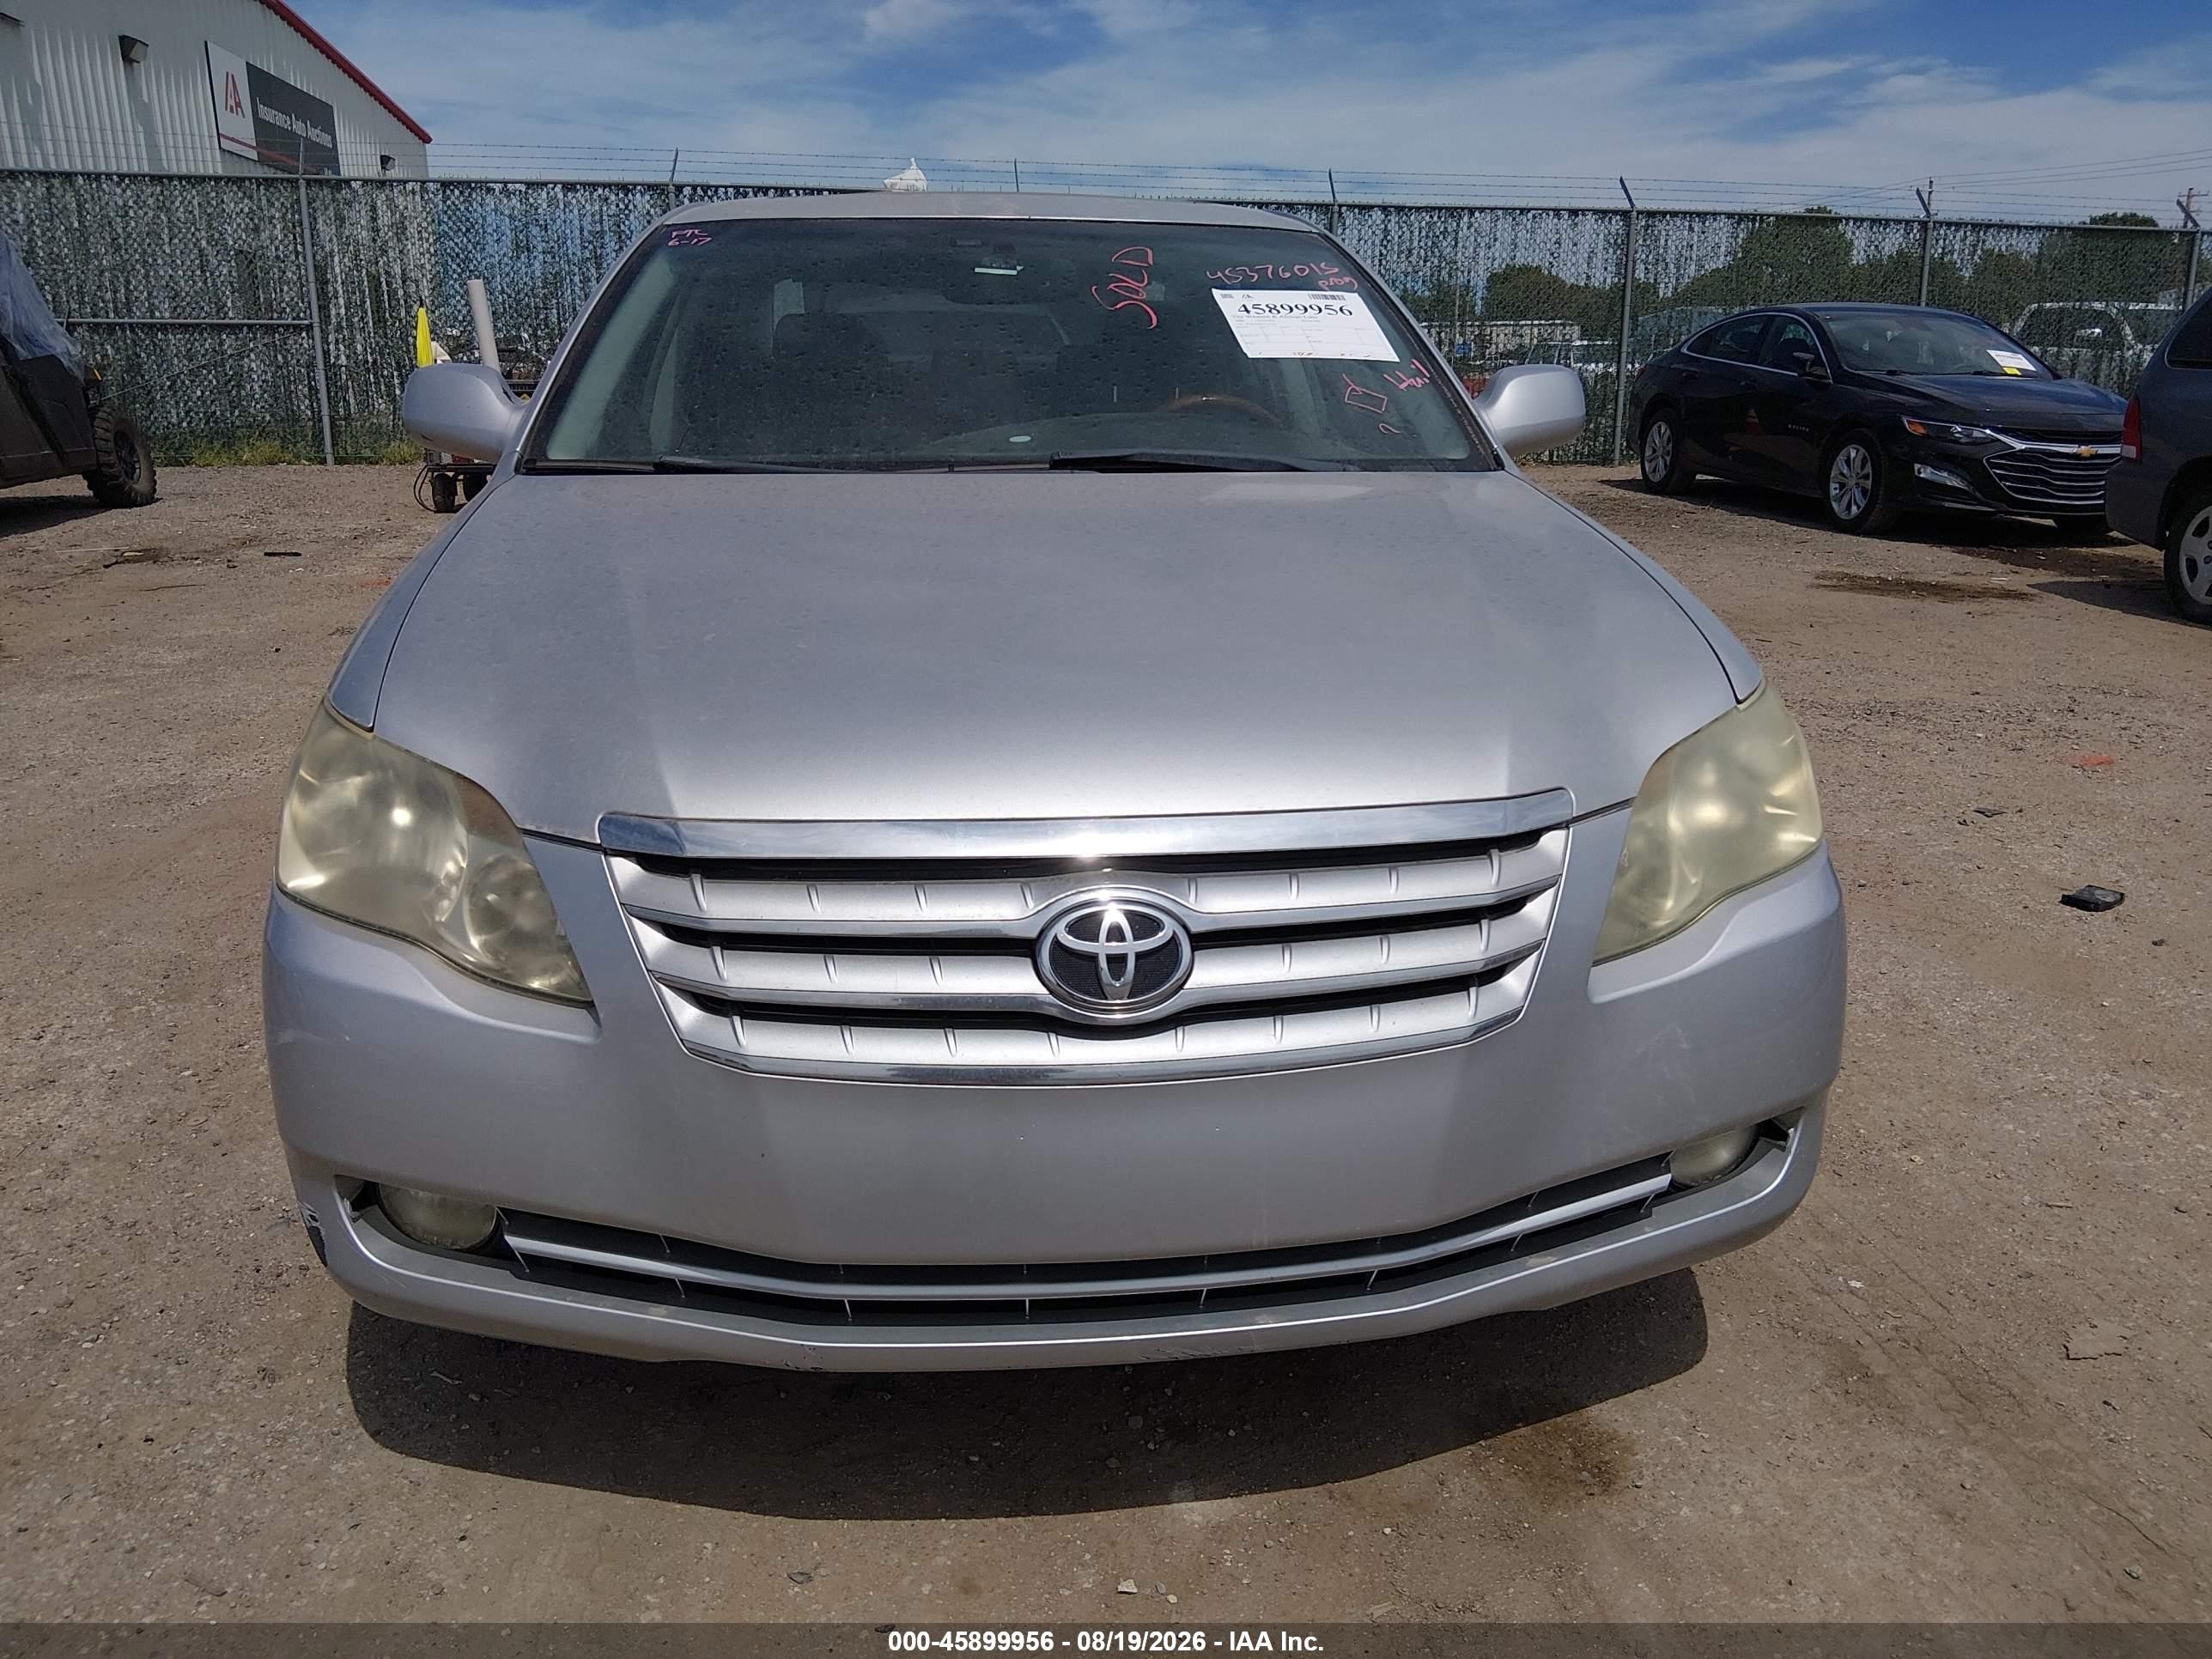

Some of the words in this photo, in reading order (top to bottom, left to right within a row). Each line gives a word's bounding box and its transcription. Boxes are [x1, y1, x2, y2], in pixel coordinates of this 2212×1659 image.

[256, 96, 292, 131] Insurance
[291, 112, 307, 137] Auto
[307, 119, 333, 149] Auctions
[667, 237, 712, 246] 6-17
[1237, 302, 1353, 317] 45899956
